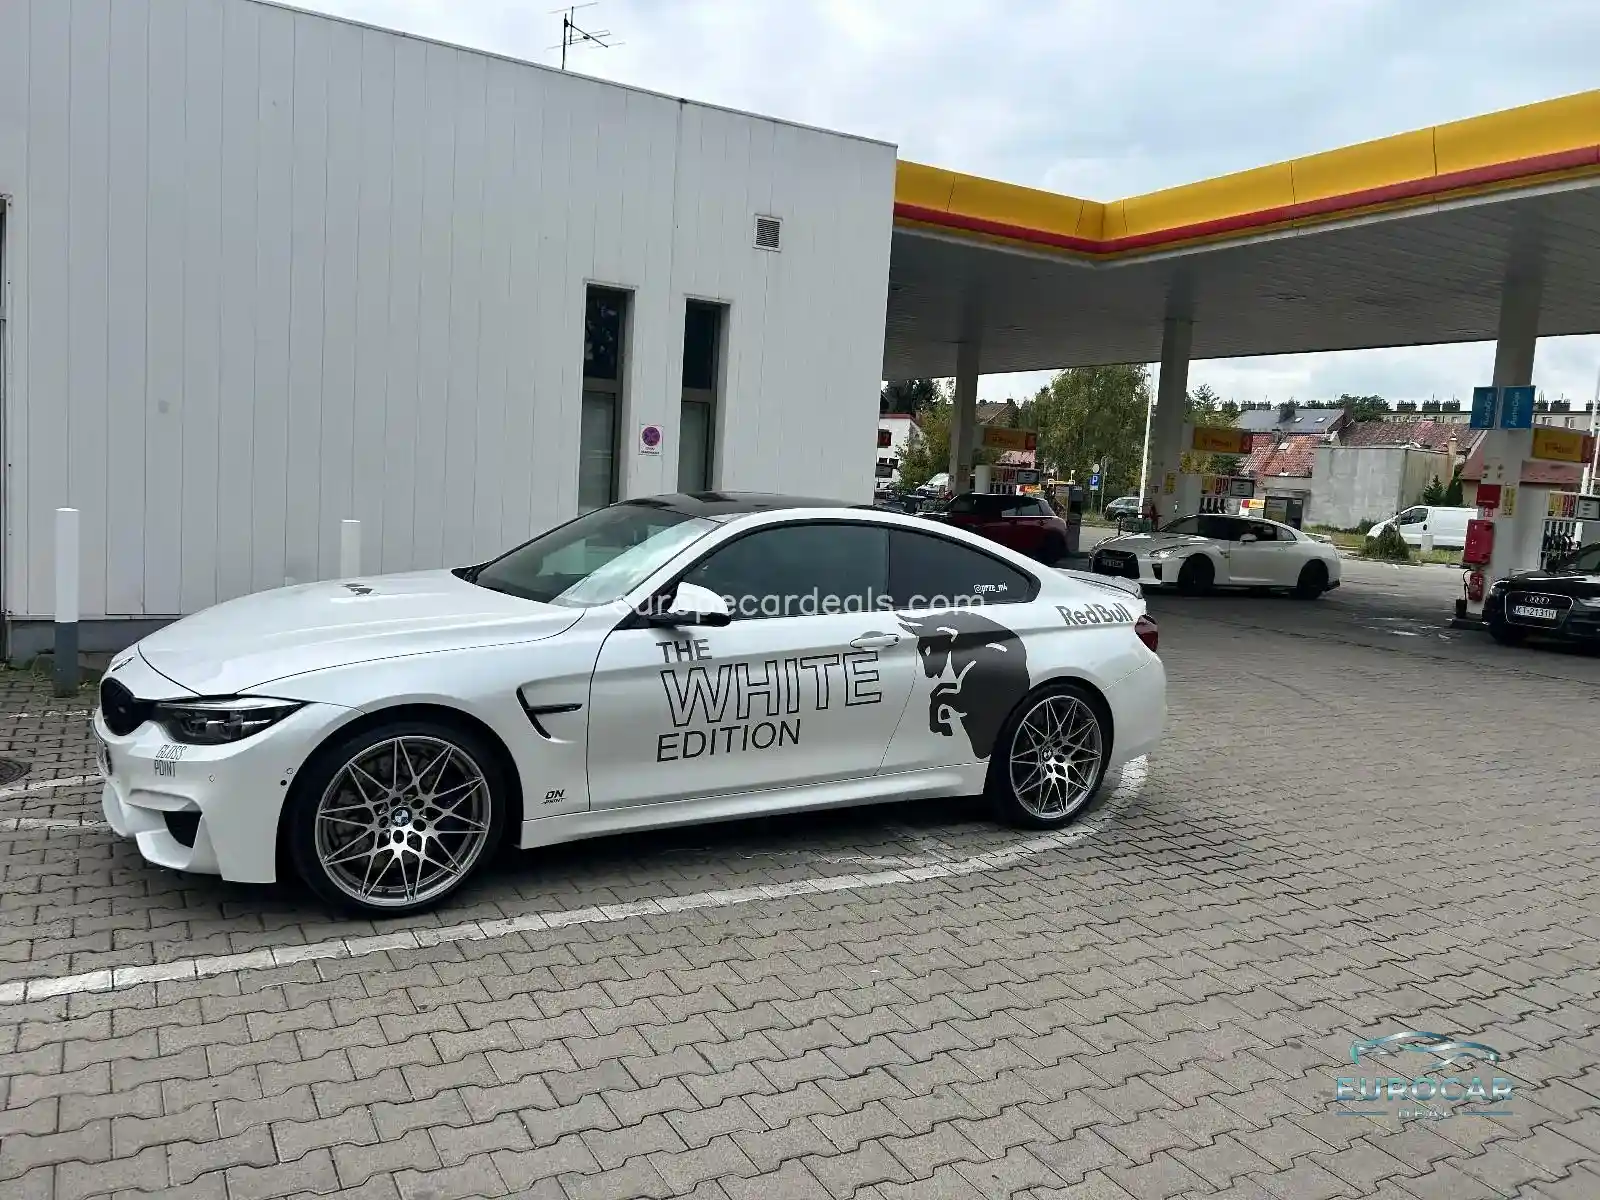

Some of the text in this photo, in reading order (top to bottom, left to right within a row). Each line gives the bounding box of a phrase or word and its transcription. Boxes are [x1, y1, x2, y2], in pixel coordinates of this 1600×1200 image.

[656, 638, 713, 663] THE
[660, 651, 883, 728] WHITE
[656, 718, 801, 763] EDITION
[154, 759, 177, 777] POINT
[545, 789, 565, 800] ON
